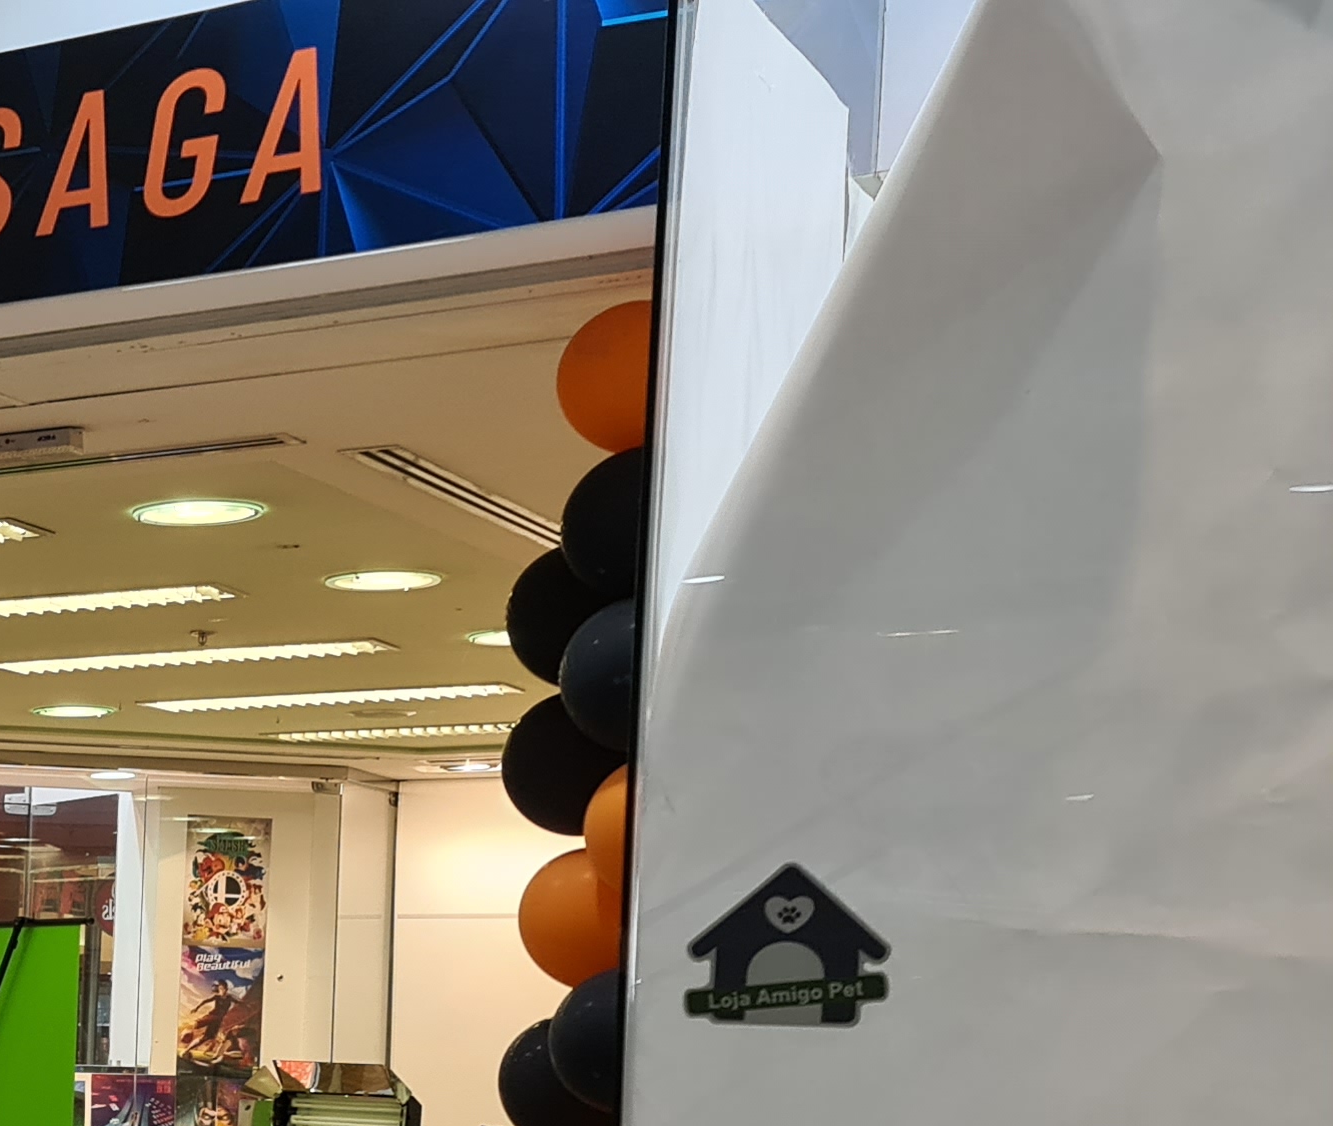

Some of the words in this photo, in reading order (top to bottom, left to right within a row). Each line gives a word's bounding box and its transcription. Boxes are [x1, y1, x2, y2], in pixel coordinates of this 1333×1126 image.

[708, 991, 752, 1011] Loja
[756, 984, 823, 1006] Amigo
[828, 980, 865, 999] Pet
